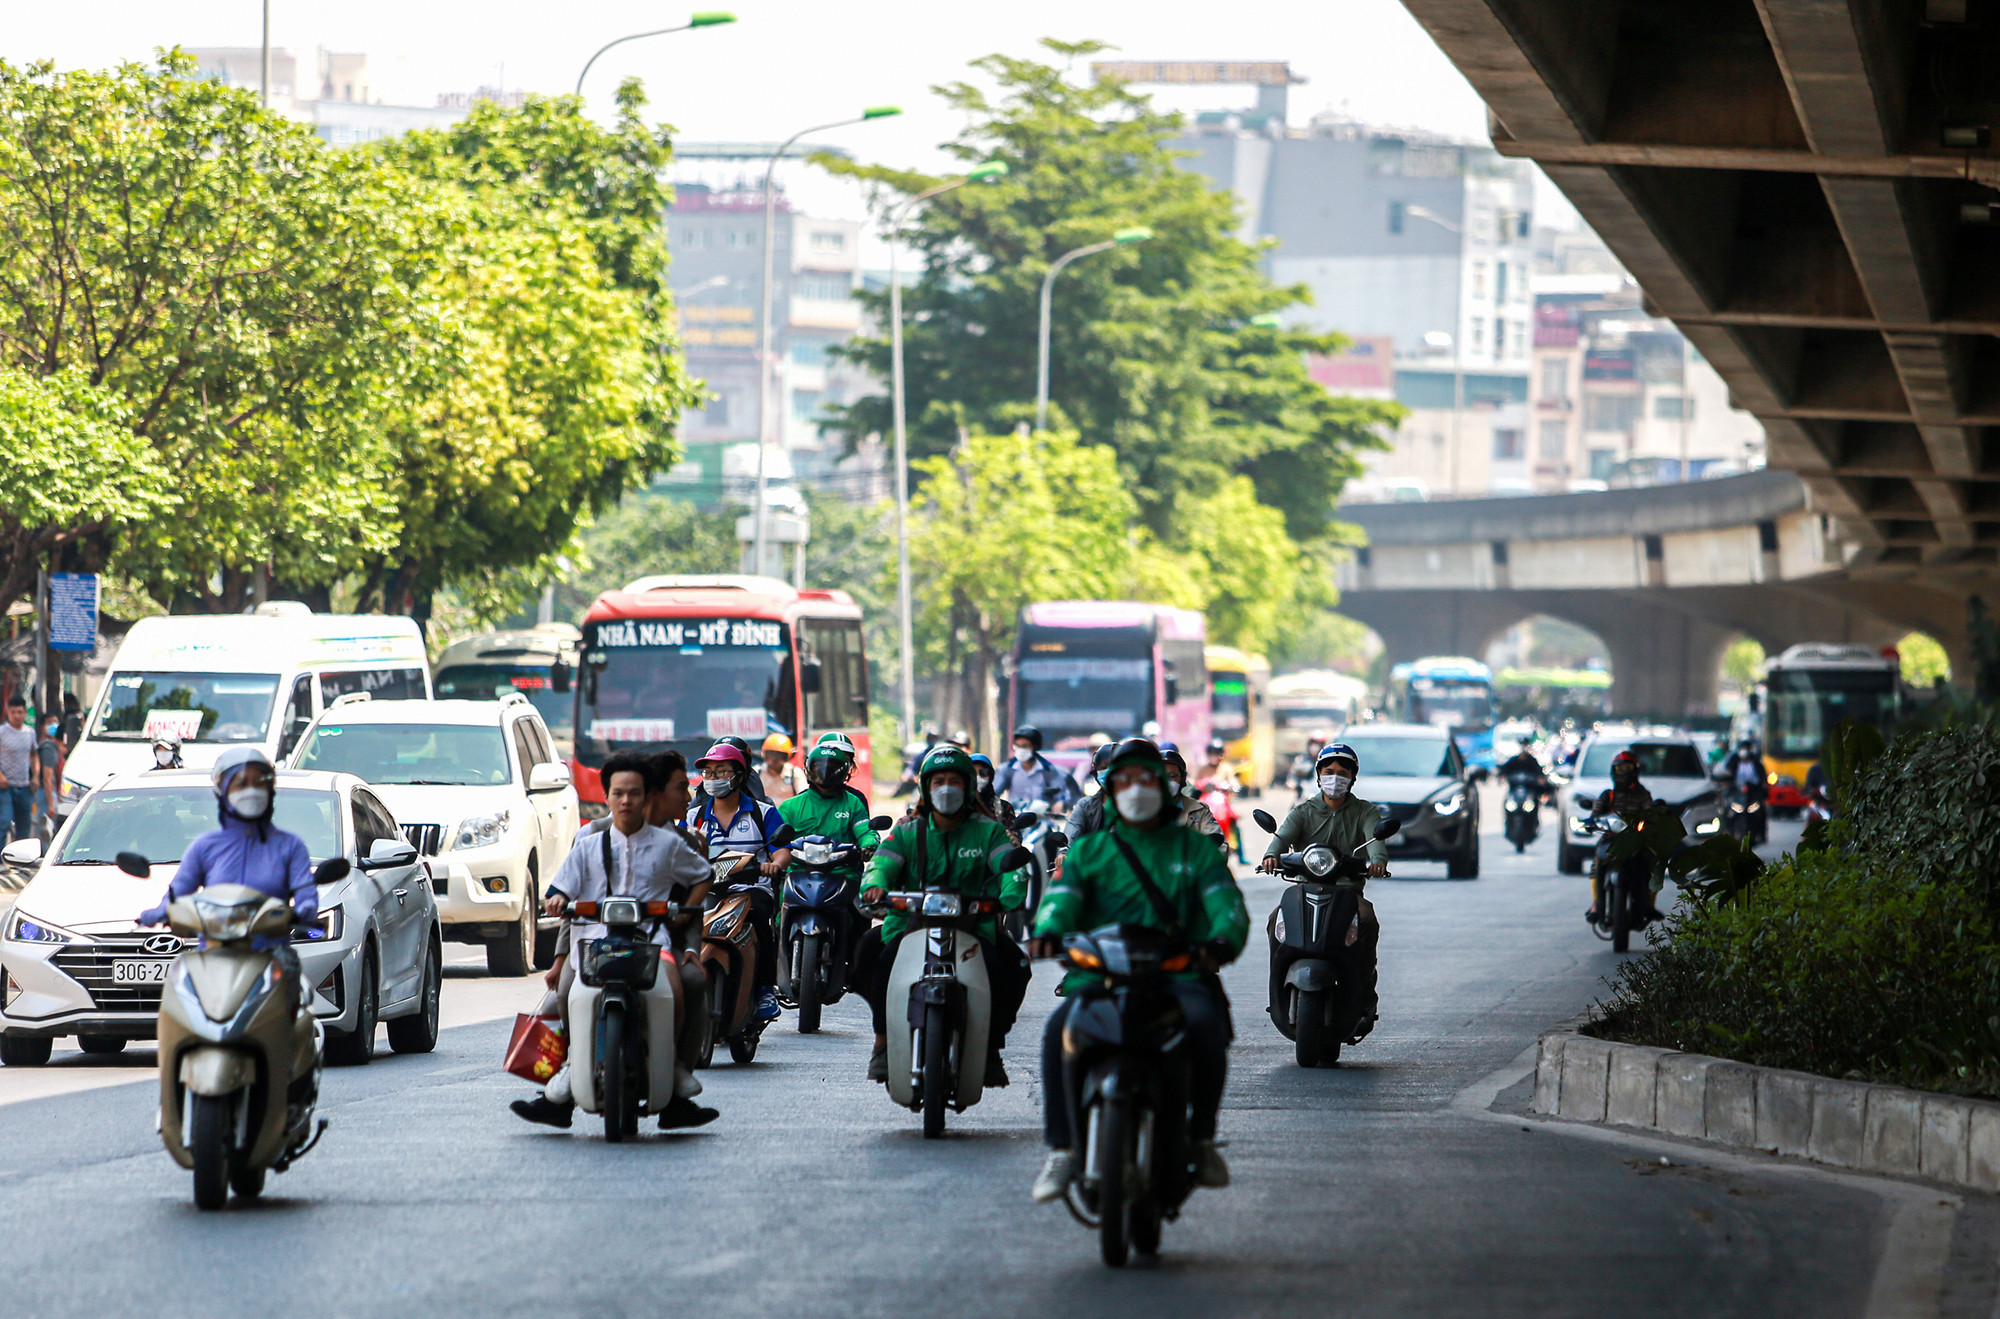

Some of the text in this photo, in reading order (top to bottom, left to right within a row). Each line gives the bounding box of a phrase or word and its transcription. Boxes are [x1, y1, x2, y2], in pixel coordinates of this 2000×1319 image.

[597, 620, 638, 647] NHÃ
[640, 623, 684, 646] NAM
[699, 619, 729, 645] MỸ
[731, 620, 781, 646] ĐÌNH
[934, 756, 955, 764] Grab
